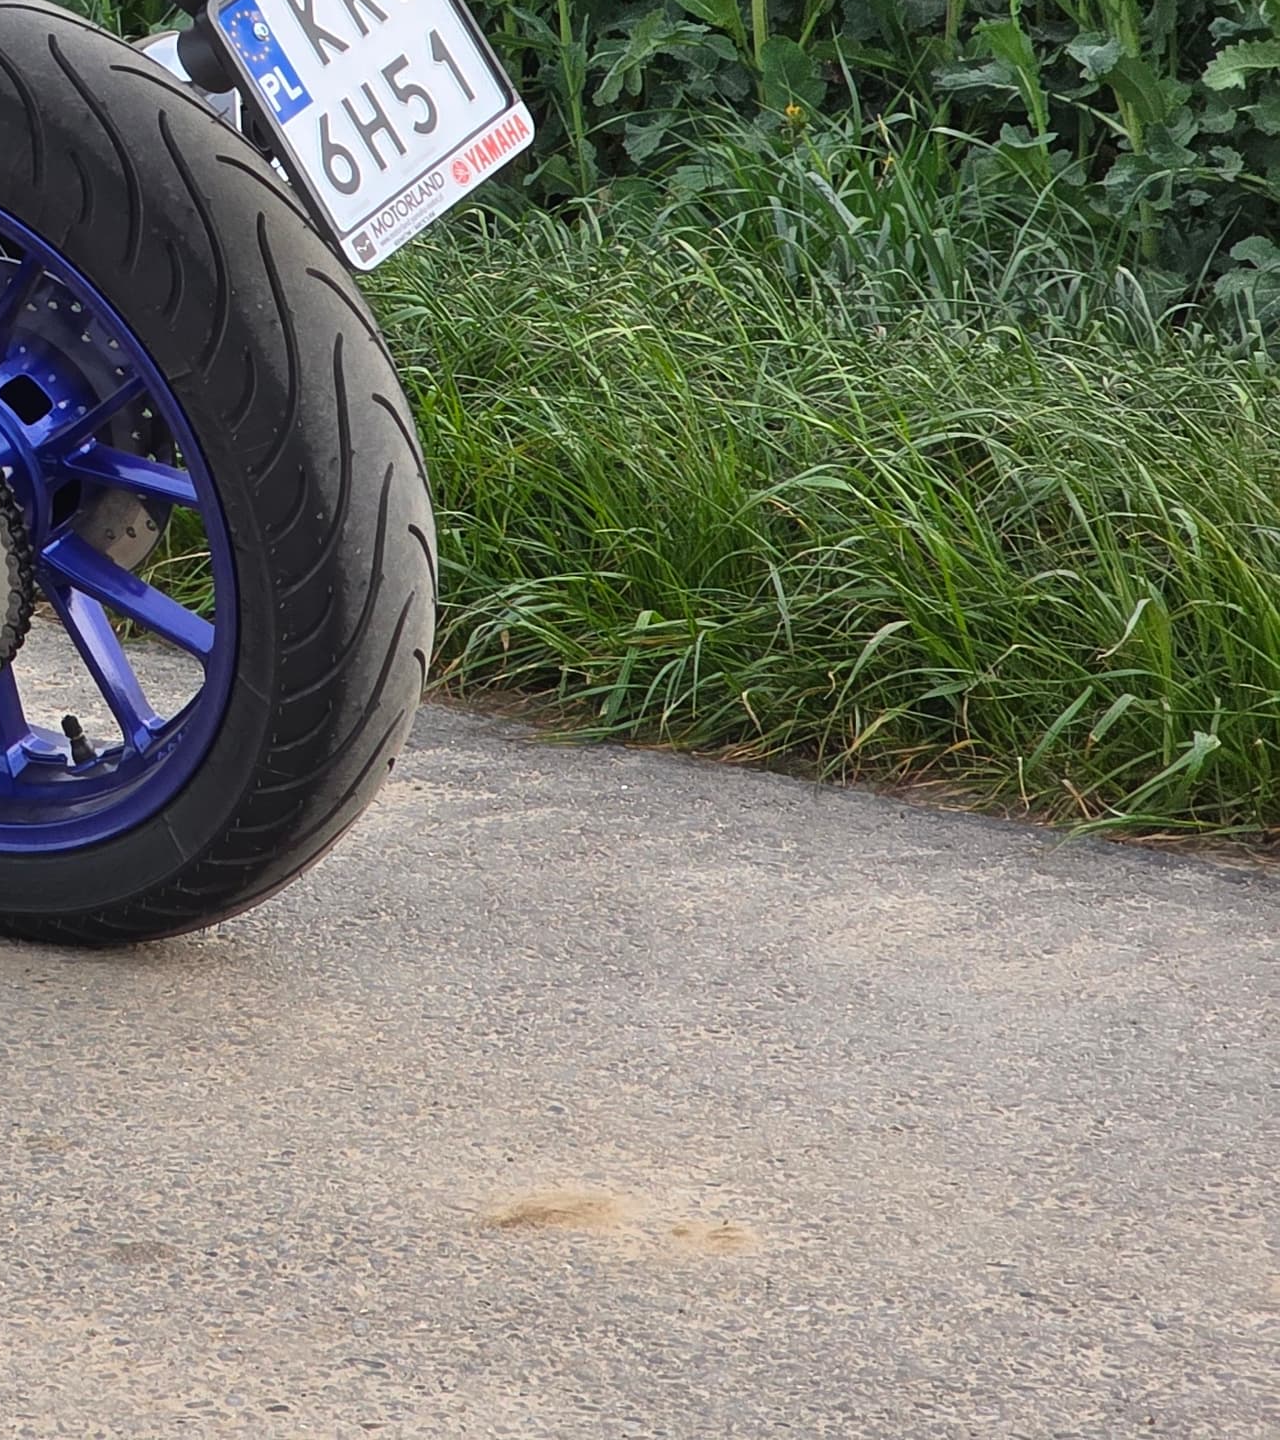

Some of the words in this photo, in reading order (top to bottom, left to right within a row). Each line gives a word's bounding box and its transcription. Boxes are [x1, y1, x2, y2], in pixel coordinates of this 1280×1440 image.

[258, 65, 304, 112] PL
[318, 28, 476, 196] 6H51
[464, 113, 531, 174] YAMAHA
[370, 171, 445, 240] MOTORLAND
